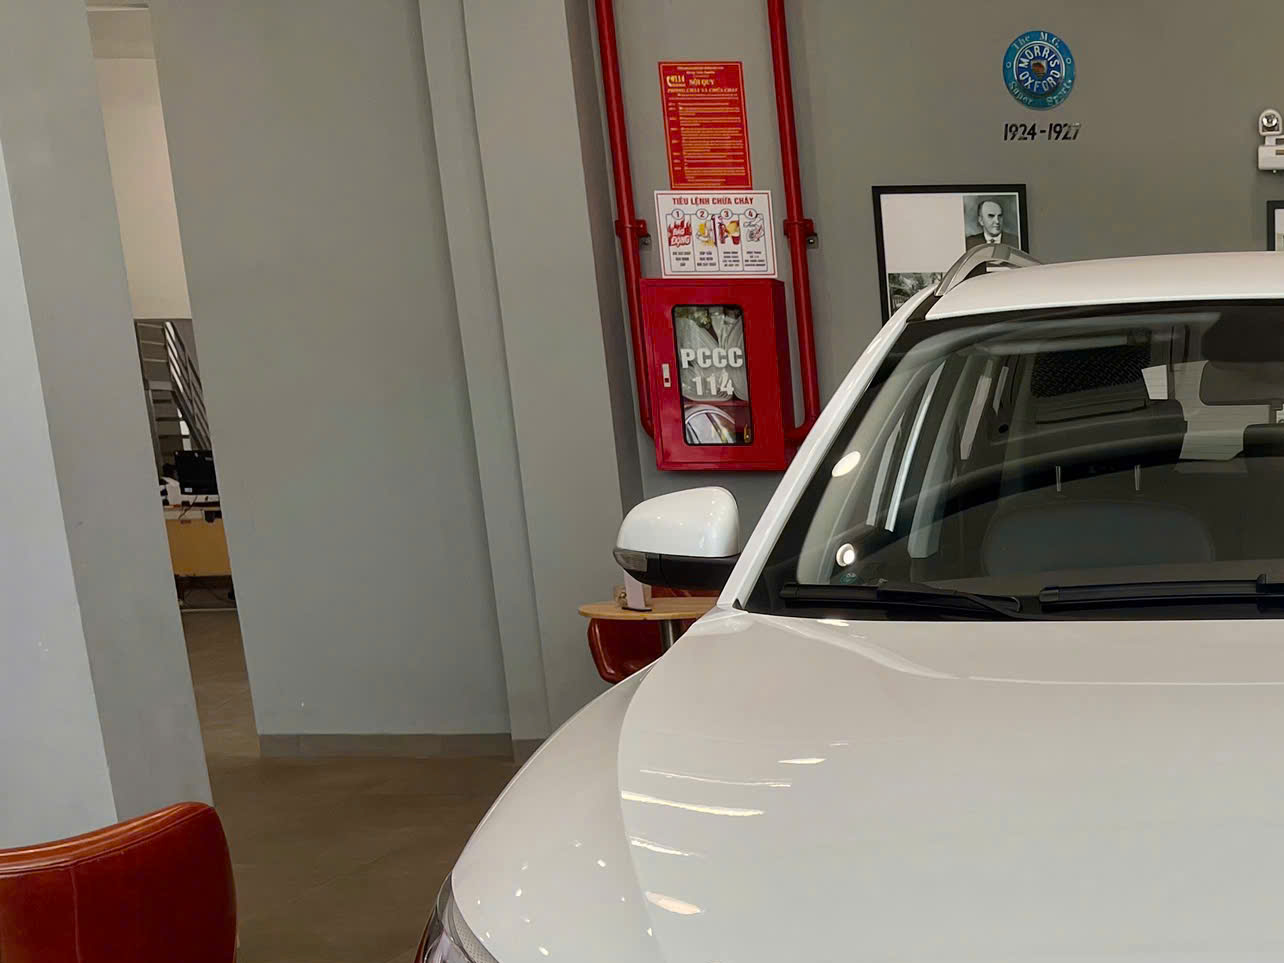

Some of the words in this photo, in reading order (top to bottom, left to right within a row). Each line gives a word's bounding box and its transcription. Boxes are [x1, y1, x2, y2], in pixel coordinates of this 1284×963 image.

[1018, 45, 1060, 68] MORRIS
[1019, 69, 1061, 92] OXFORD
[1003, 122, 1081, 141] 1924-1927
[680, 347, 743, 369] PCCC
[692, 369, 734, 395] 114
